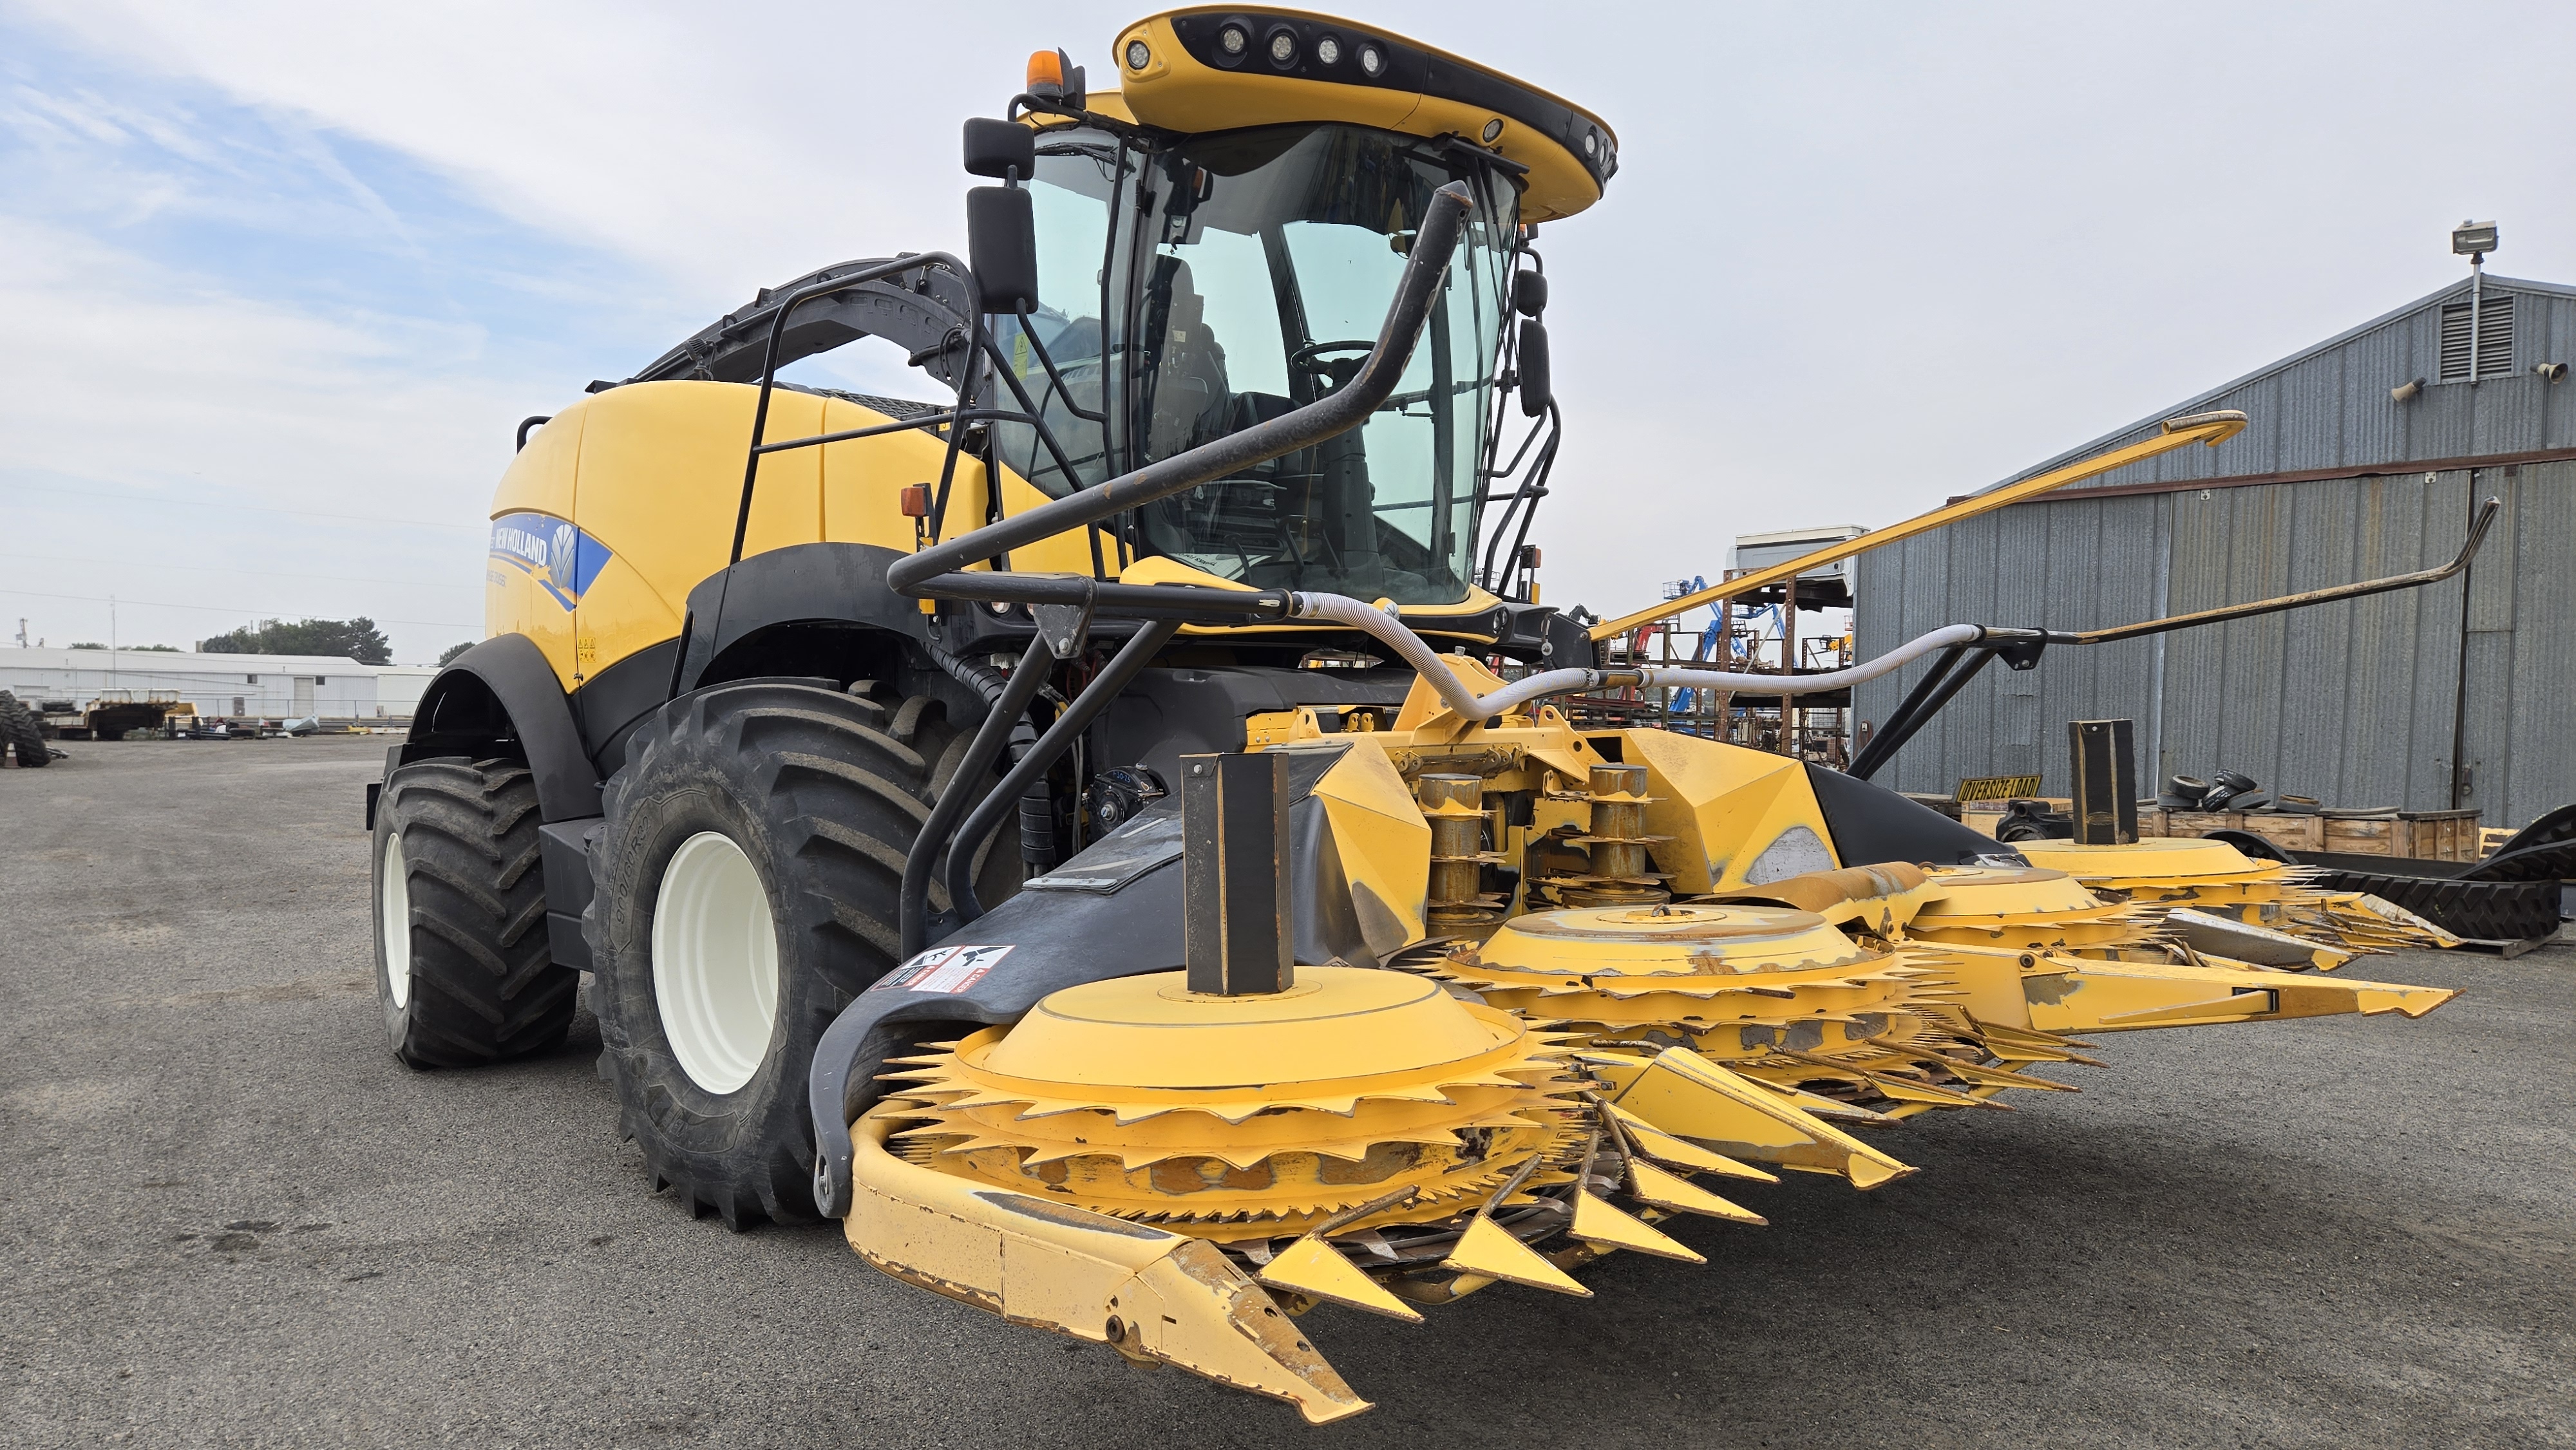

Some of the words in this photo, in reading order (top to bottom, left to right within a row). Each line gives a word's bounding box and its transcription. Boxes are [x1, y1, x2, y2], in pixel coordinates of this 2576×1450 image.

[495, 527, 509, 549] NEW
[507, 528, 547, 566] HOLLAND
[1962, 778, 2010, 800] OVERSIZE
[2009, 778, 2036, 798] LOAD
[616, 816, 651, 925] 900/60R32
[954, 974, 980, 993] DANGER
